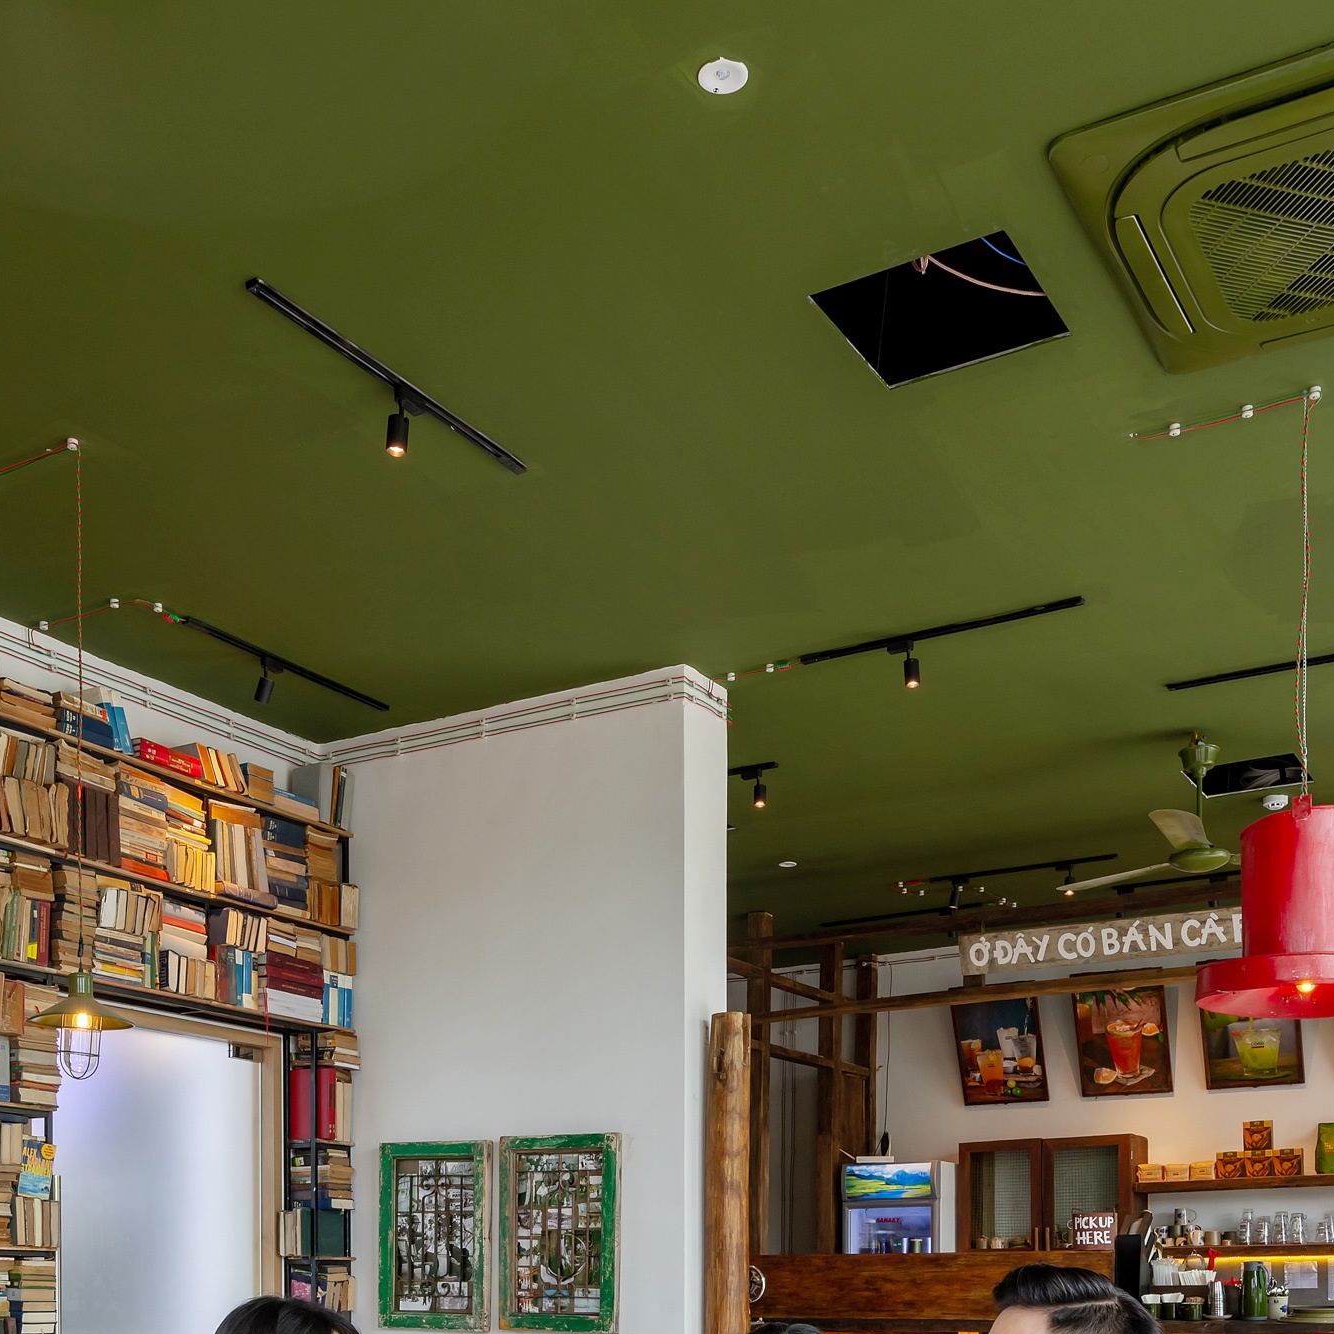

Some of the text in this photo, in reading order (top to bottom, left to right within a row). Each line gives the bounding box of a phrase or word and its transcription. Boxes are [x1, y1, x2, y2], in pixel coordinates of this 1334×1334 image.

[969, 936, 991, 966] Ở
[993, 932, 1049, 965] ĐÂY
[1057, 926, 1096, 960] CÓ
[1101, 920, 1174, 955] BÁN
[1181, 912, 1227, 947] CÀ
[1099, 1216, 1114, 1228] UP
[1075, 1230, 1112, 1245] HERE
